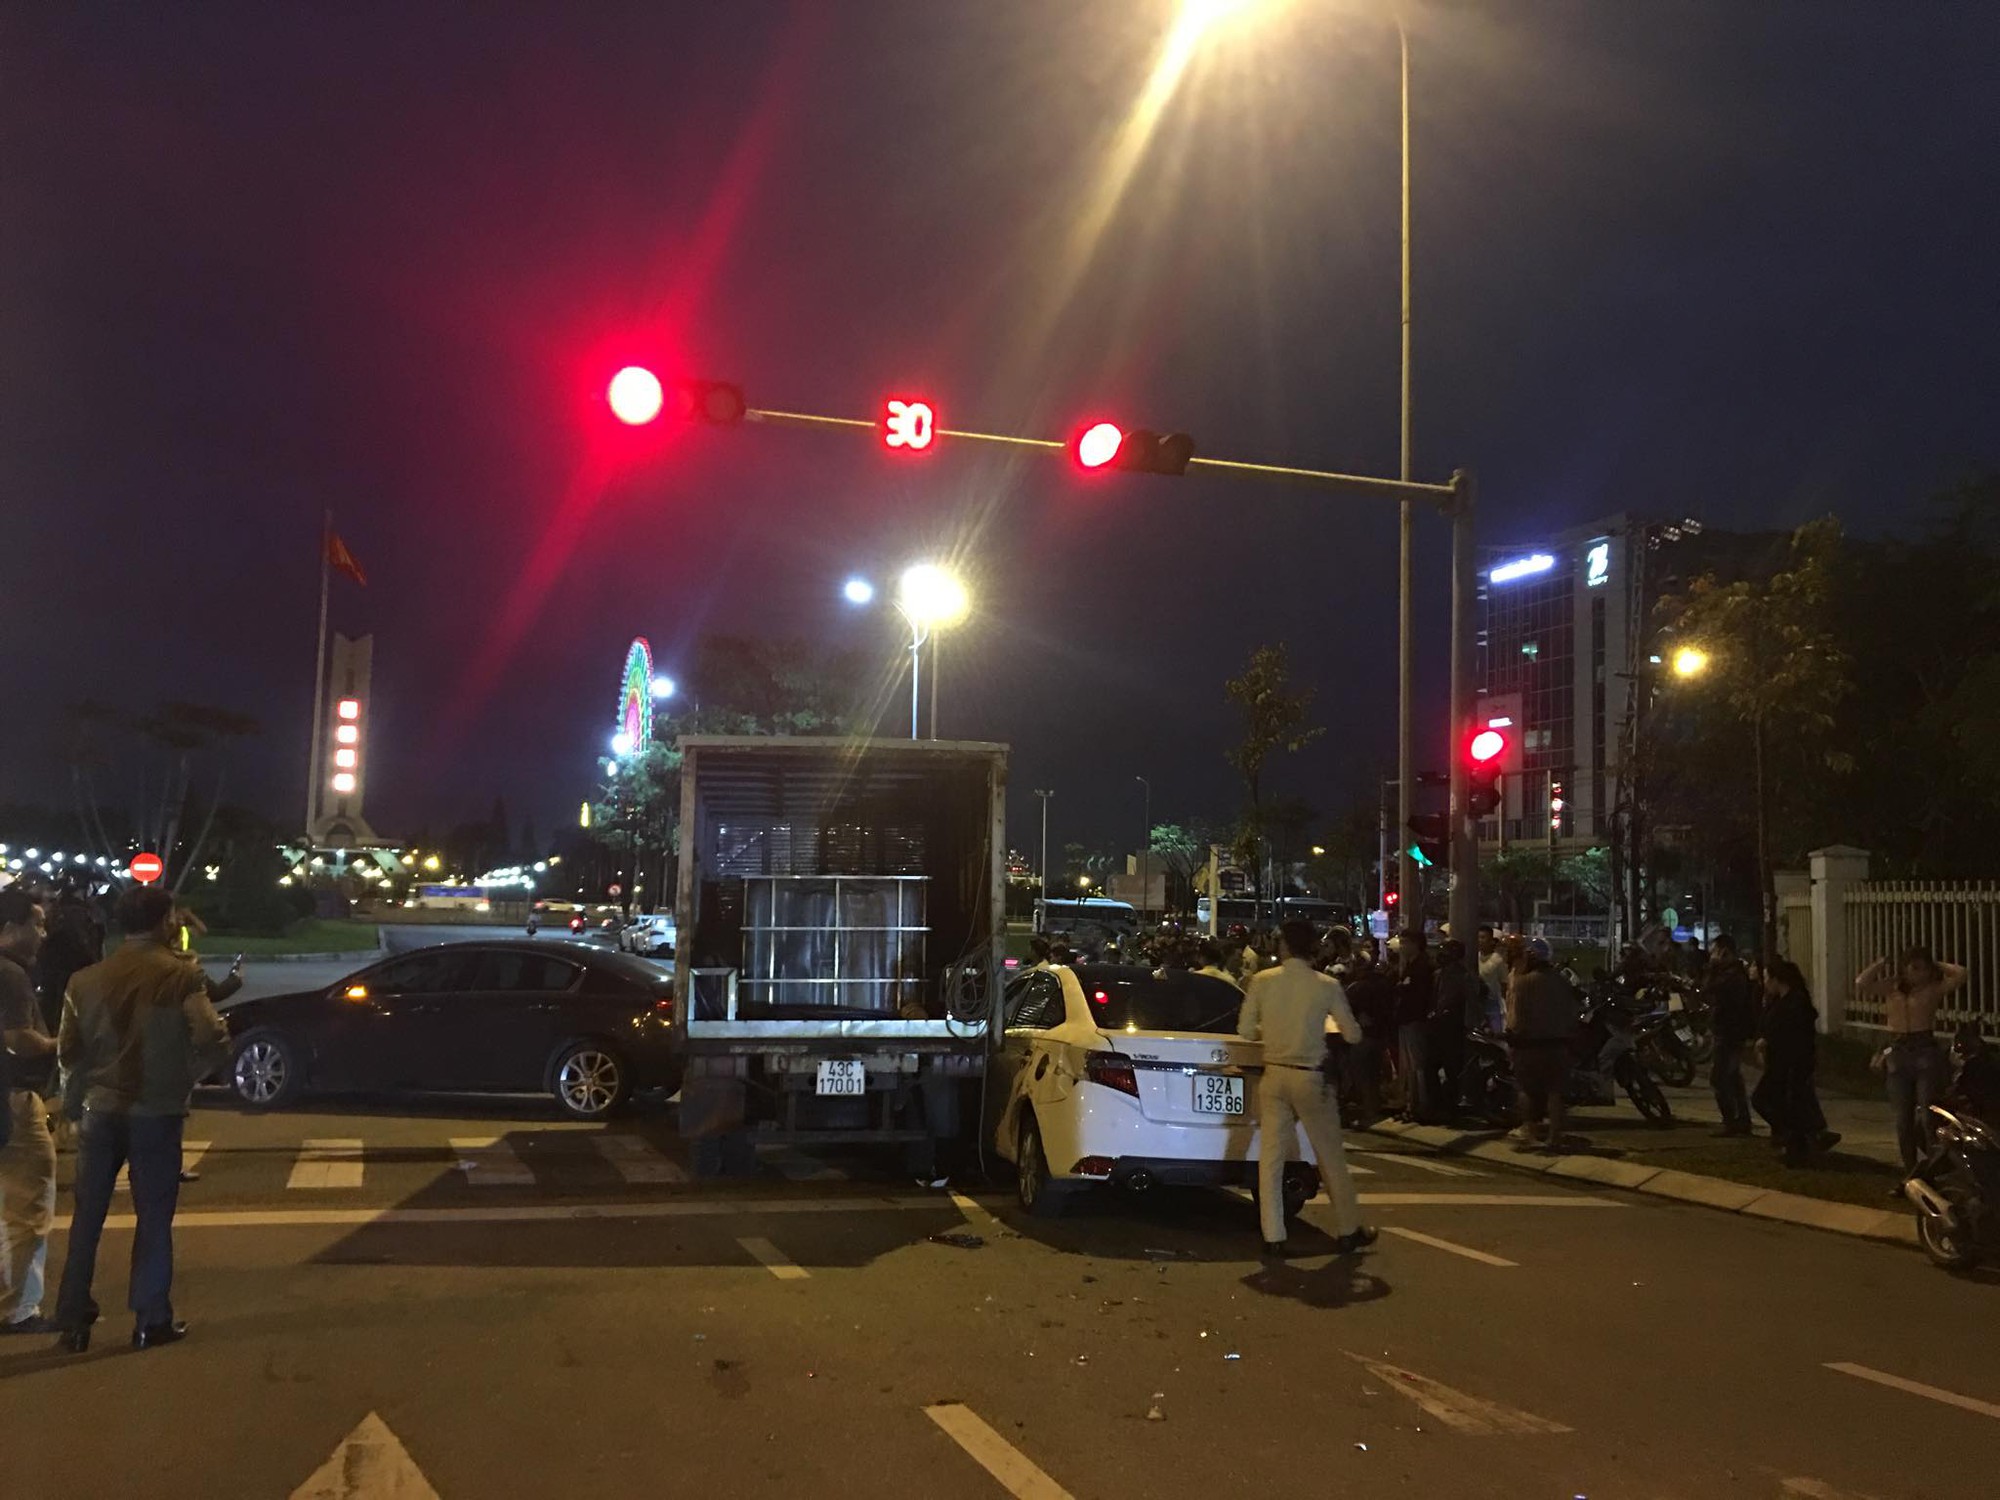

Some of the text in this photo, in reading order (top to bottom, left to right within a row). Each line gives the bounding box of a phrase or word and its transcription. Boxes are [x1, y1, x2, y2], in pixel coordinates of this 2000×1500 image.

[886, 400, 932, 448] 30
[829, 1061, 854, 1077] 43C
[820, 1078, 862, 1093] 170.01
[1207, 1077, 1232, 1094] 92A
[1197, 1094, 1242, 1112] 135.86
